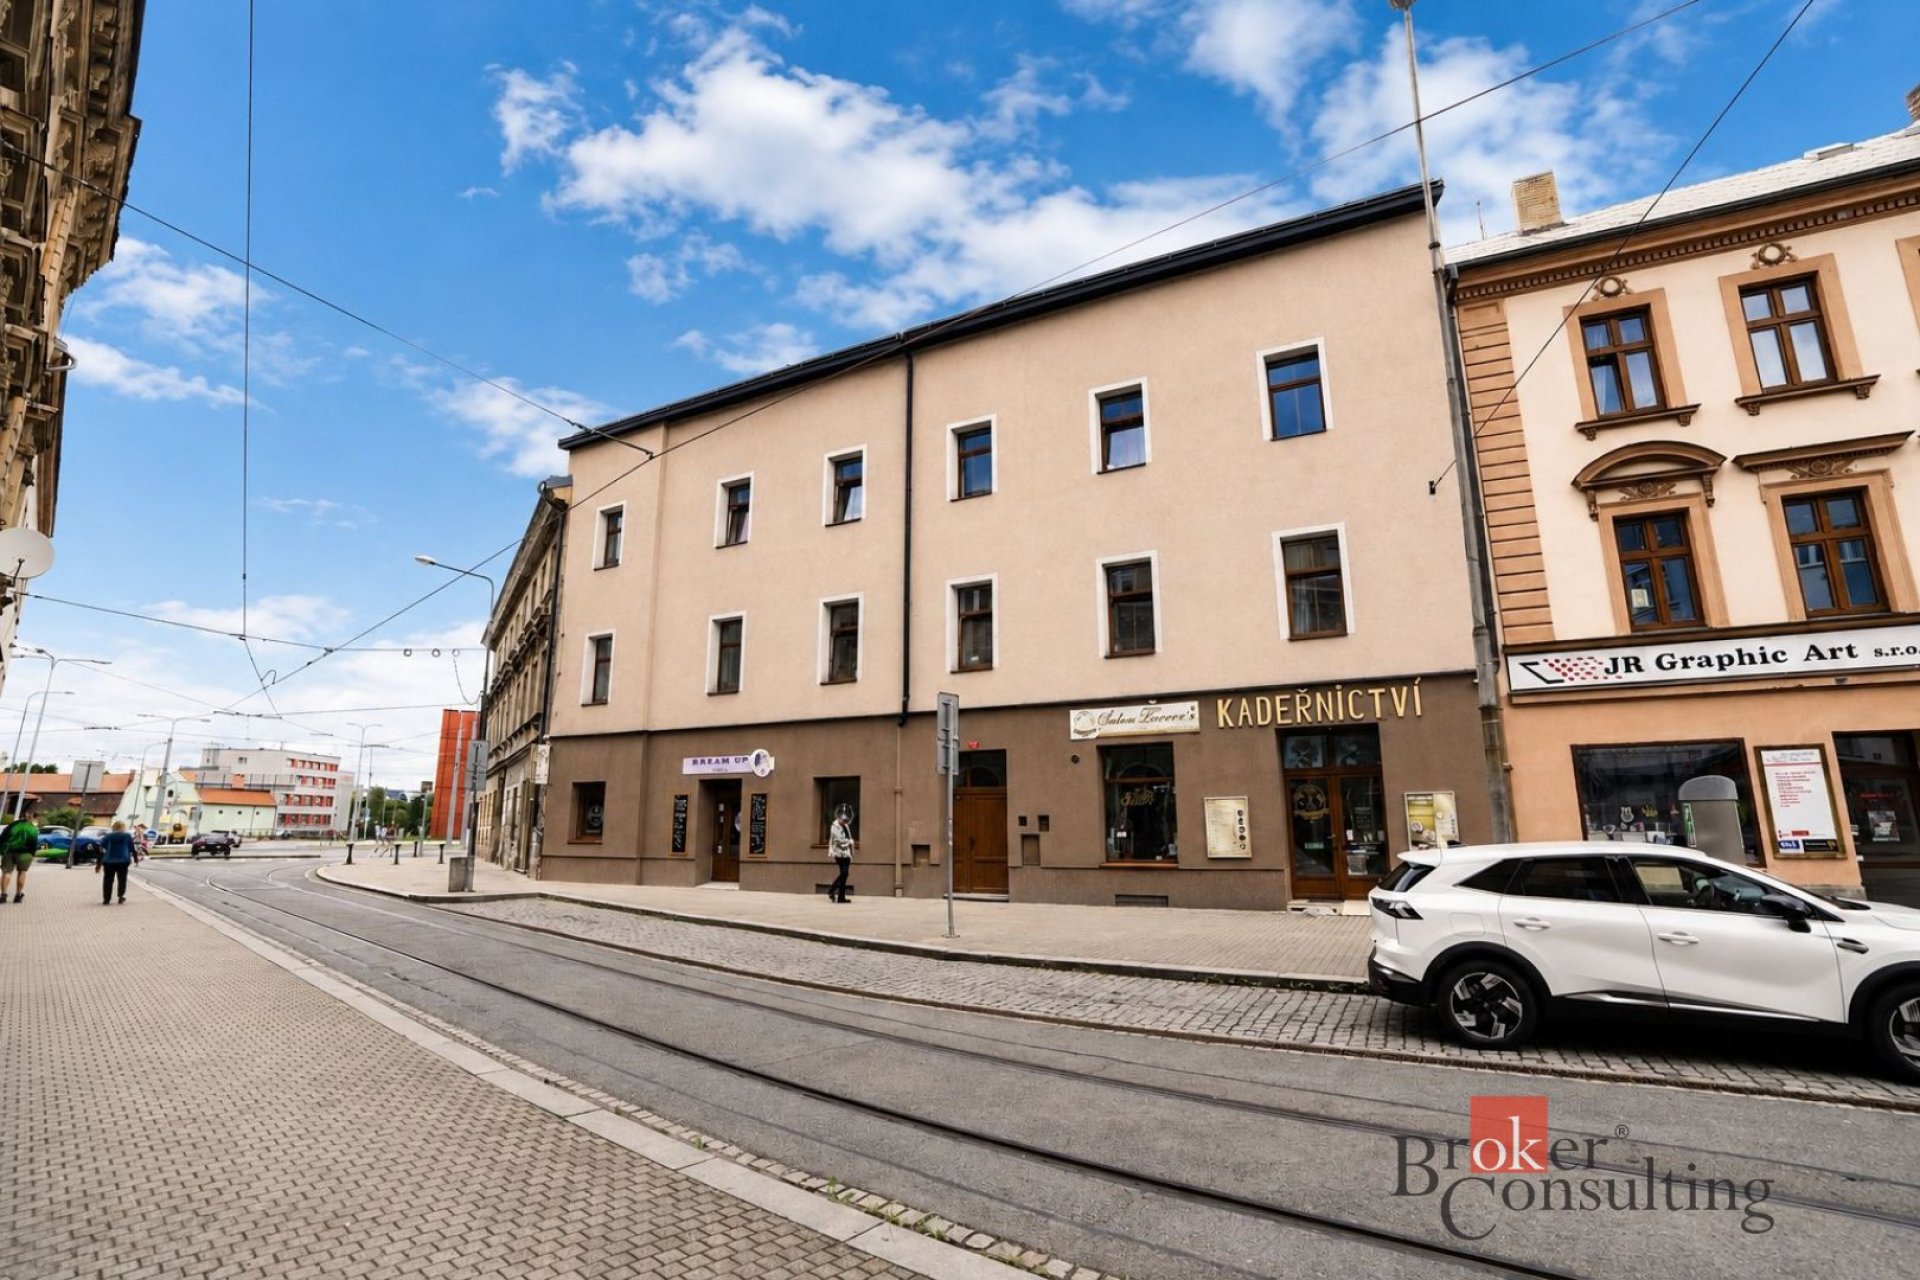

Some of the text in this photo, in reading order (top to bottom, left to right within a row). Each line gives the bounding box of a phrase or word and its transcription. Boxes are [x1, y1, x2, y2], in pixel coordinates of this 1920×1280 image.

[1604, 655, 1645, 675] JR
[1655, 645, 1788, 672] Graphic
[1803, 643, 1859, 662] Art
[1216, 677, 1422, 728] KADEŘNICTVÍ
